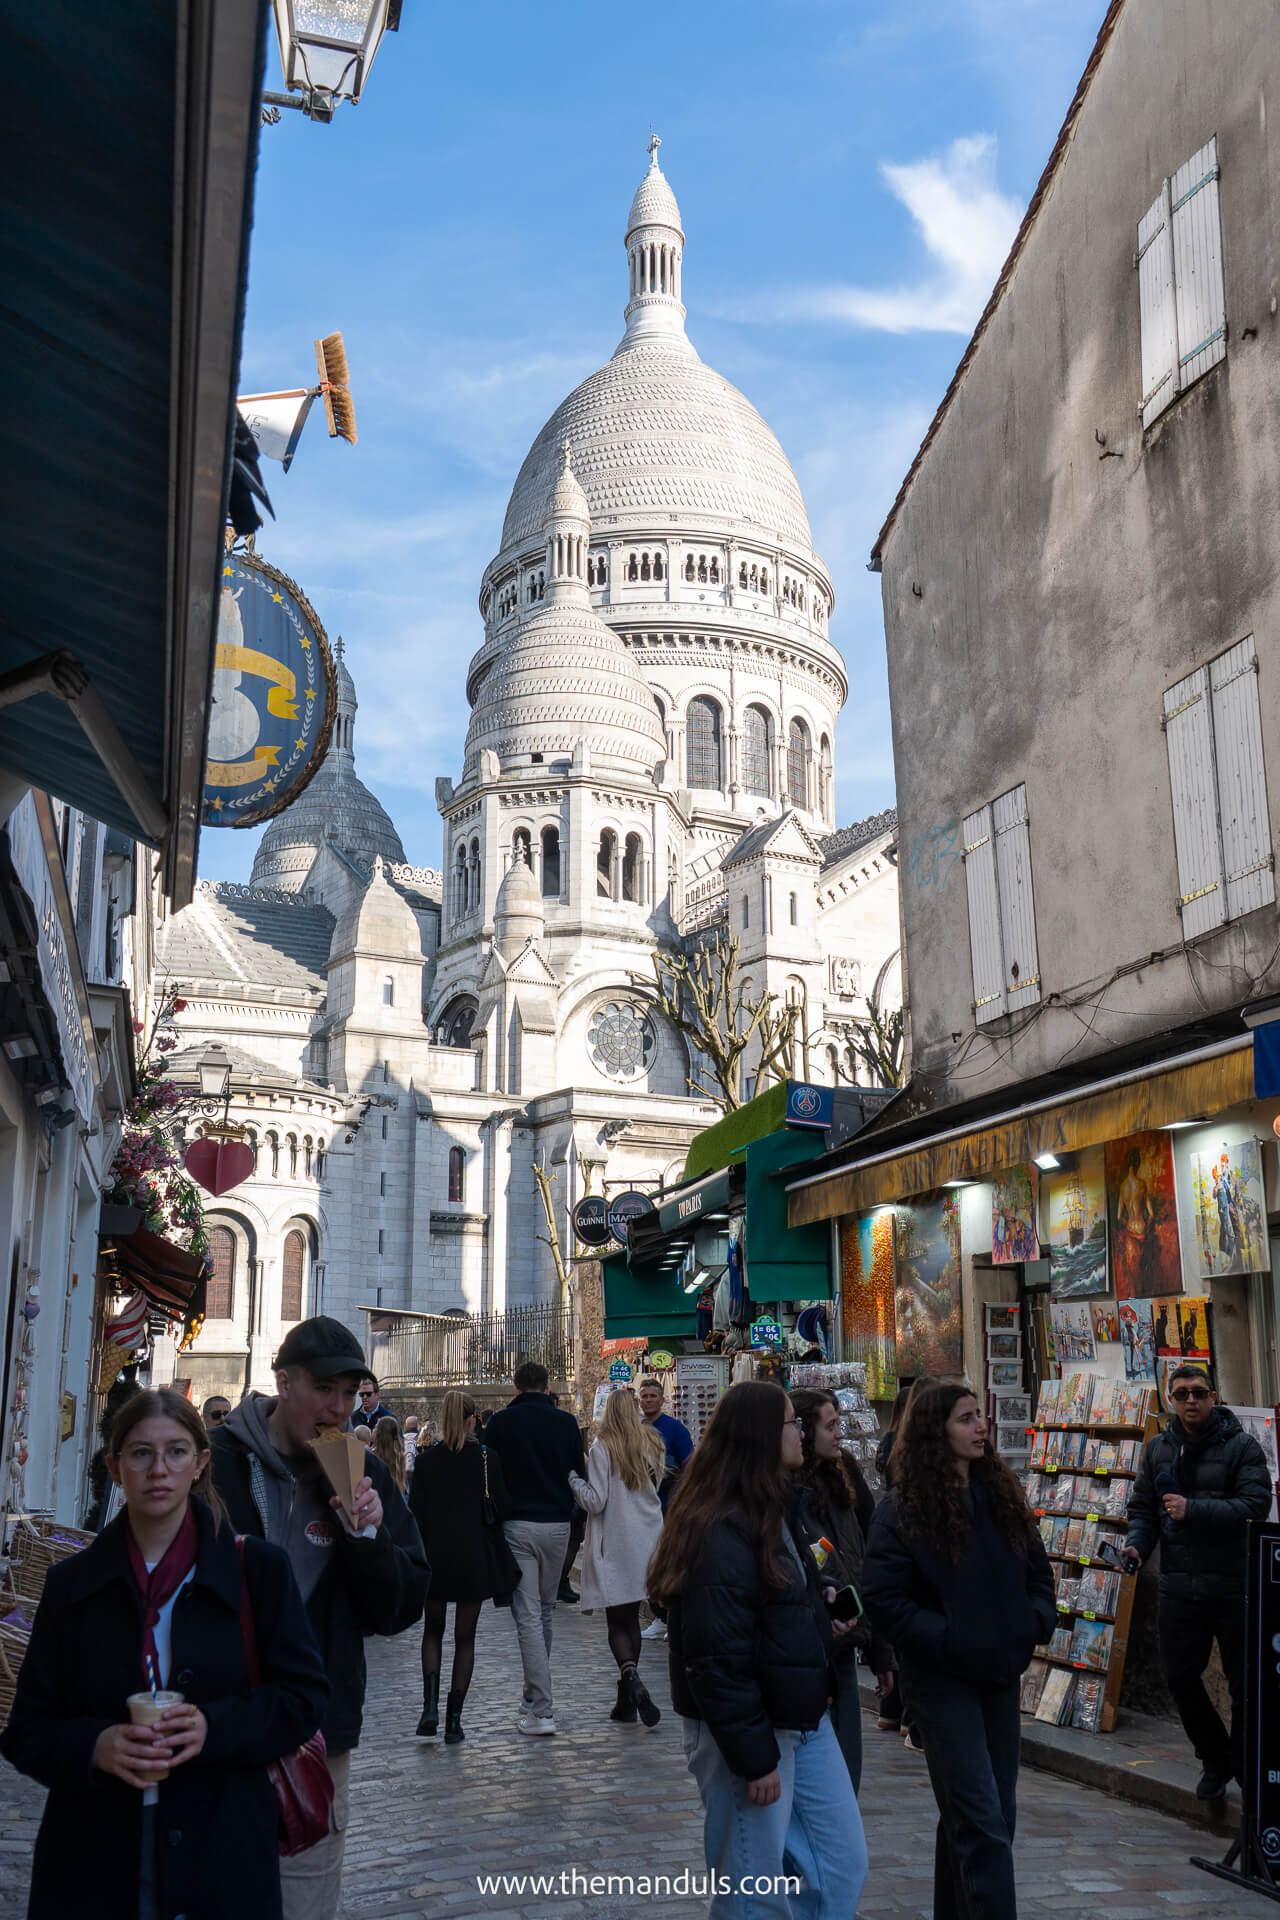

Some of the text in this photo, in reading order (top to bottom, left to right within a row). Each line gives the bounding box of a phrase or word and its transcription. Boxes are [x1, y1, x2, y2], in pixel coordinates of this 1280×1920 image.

[949, 1117, 1068, 1177] TABLEAUX
[686, 1193, 702, 1215] PARIS
[577, 1216, 604, 1227] GUINNE
[766, 1325, 776, 1333] 6€
